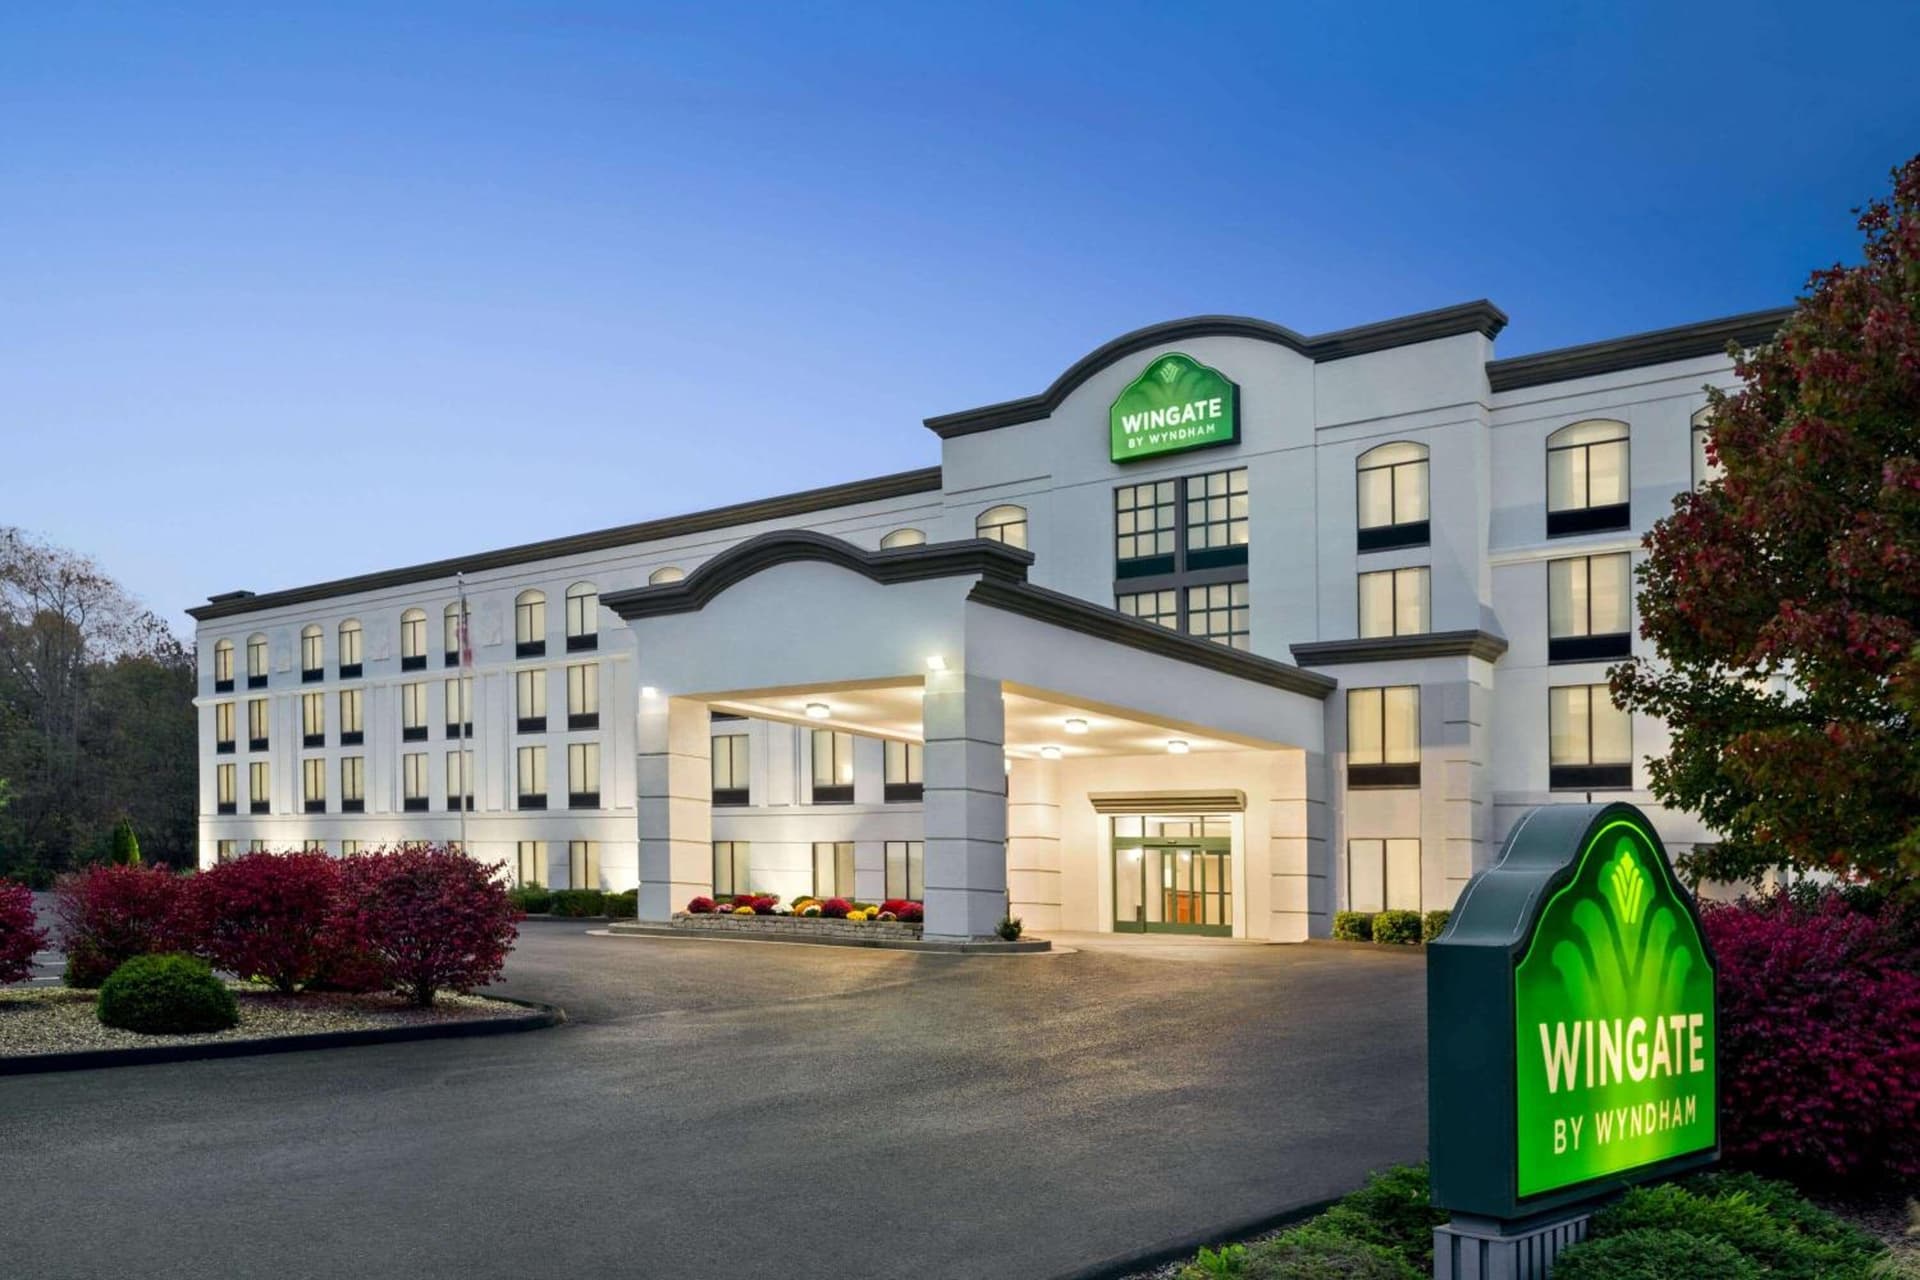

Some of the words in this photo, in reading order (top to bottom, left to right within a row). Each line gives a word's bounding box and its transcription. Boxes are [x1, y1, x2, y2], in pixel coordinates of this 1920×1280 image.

[1121, 398, 1222, 434] WINGATE
[1128, 437, 1144, 449] BY
[1149, 423, 1216, 444] WYNDHAM
[1539, 1013, 1704, 1094] WINGATE
[1554, 1115, 1583, 1155] BY
[1595, 1094, 1696, 1146] WYNDHAM
